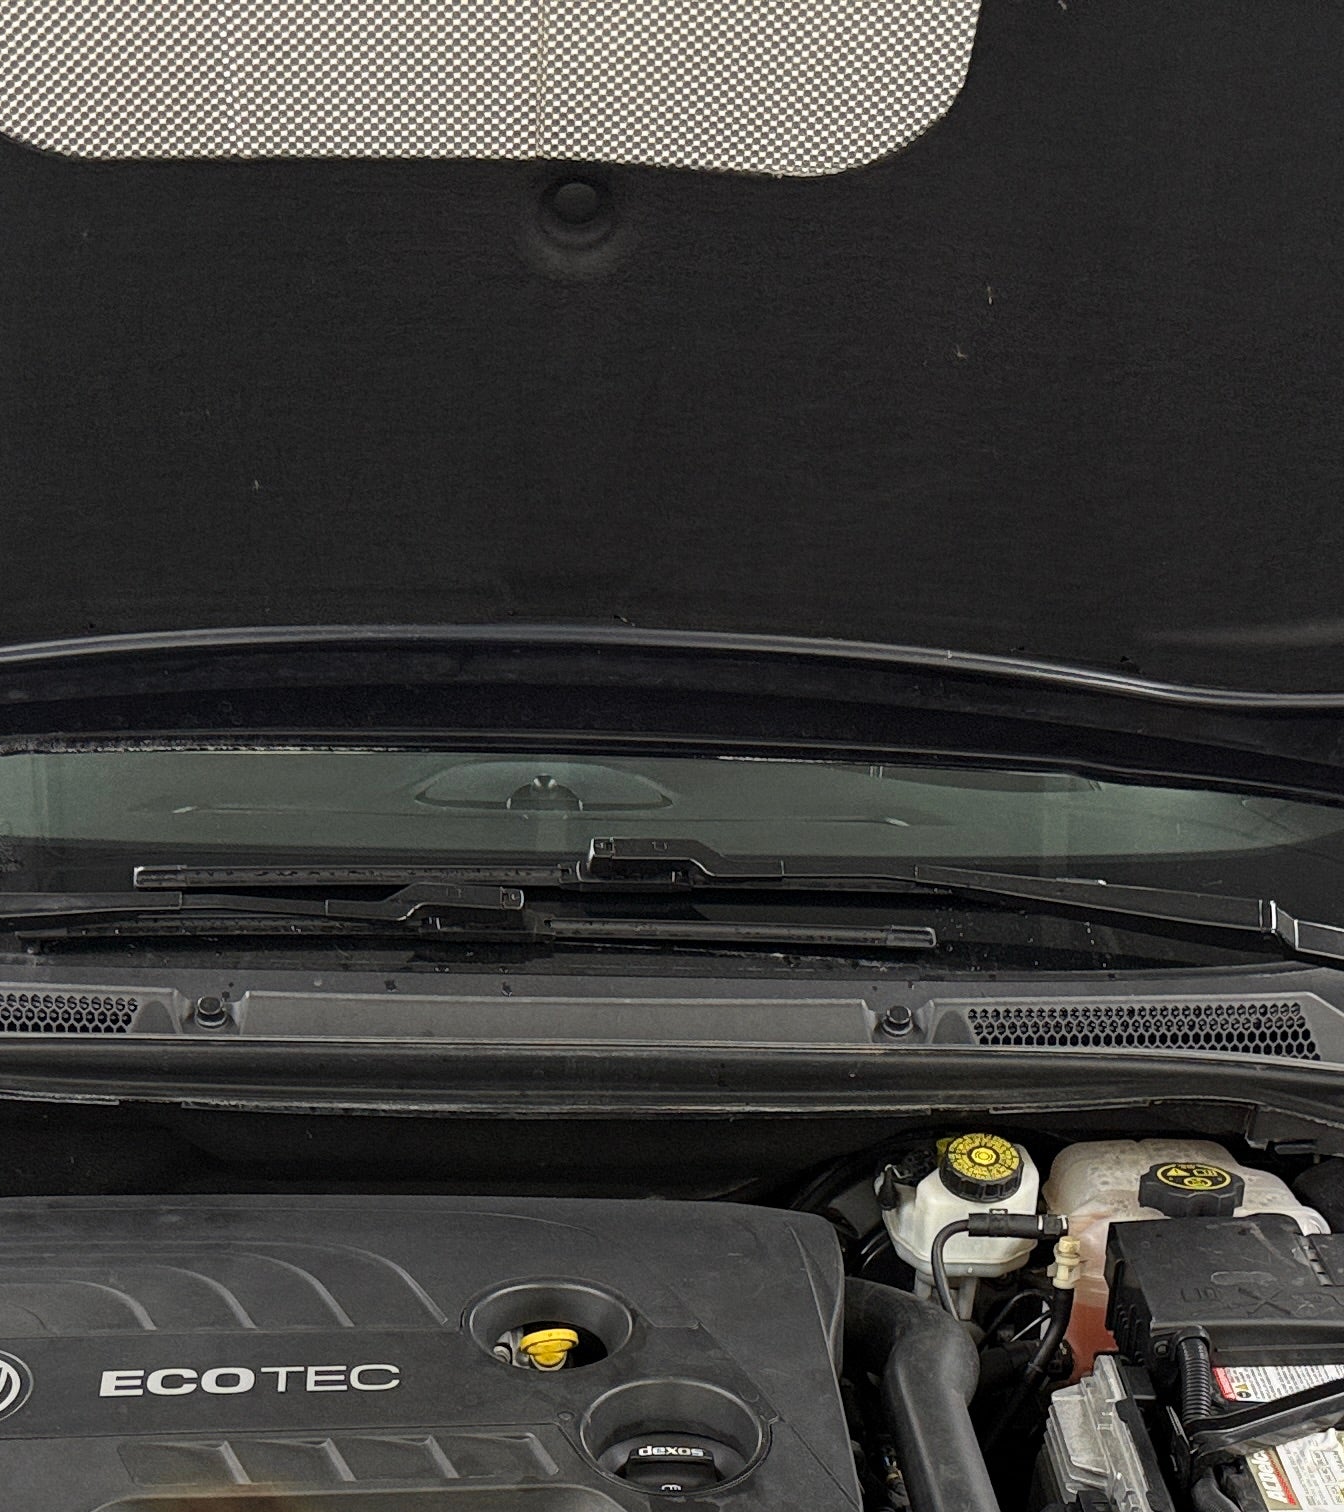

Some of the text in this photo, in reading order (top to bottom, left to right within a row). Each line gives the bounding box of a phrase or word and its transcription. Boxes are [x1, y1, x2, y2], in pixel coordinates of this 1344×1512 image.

[99, 1363, 400, 1397] ECOTEC
[638, 1445, 704, 1457] dexos
[1252, 1449, 1290, 1505] ACDelc
